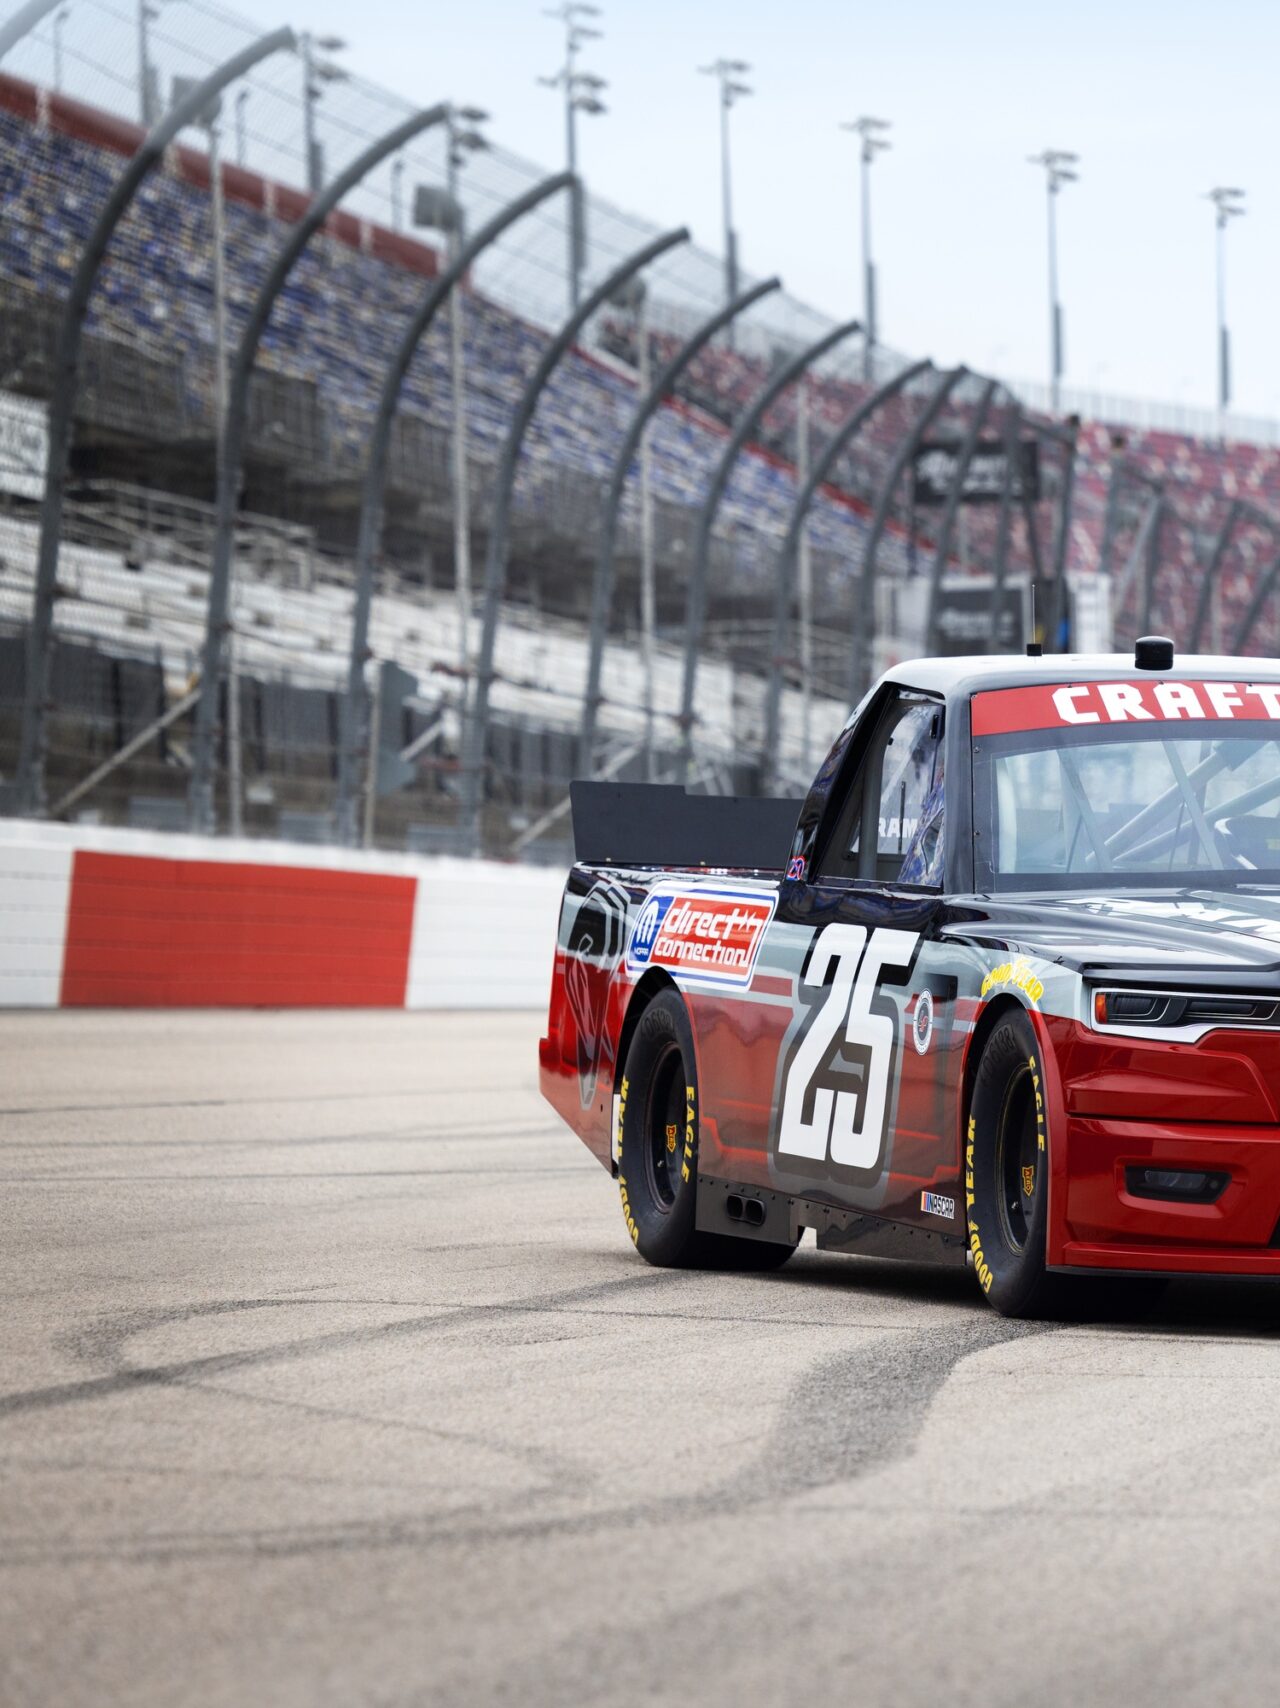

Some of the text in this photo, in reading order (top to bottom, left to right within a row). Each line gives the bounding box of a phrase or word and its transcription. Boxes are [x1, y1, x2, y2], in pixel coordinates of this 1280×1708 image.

[878, 817, 918, 838] RAM
[663, 901, 740, 940] direct
[654, 935, 751, 968] connection
[779, 922, 920, 1169] 25
[1029, 1055, 1045, 1152] EAGLE
[681, 1086, 695, 1184] EAGLE
[921, 1191, 955, 1219] NASCAR
